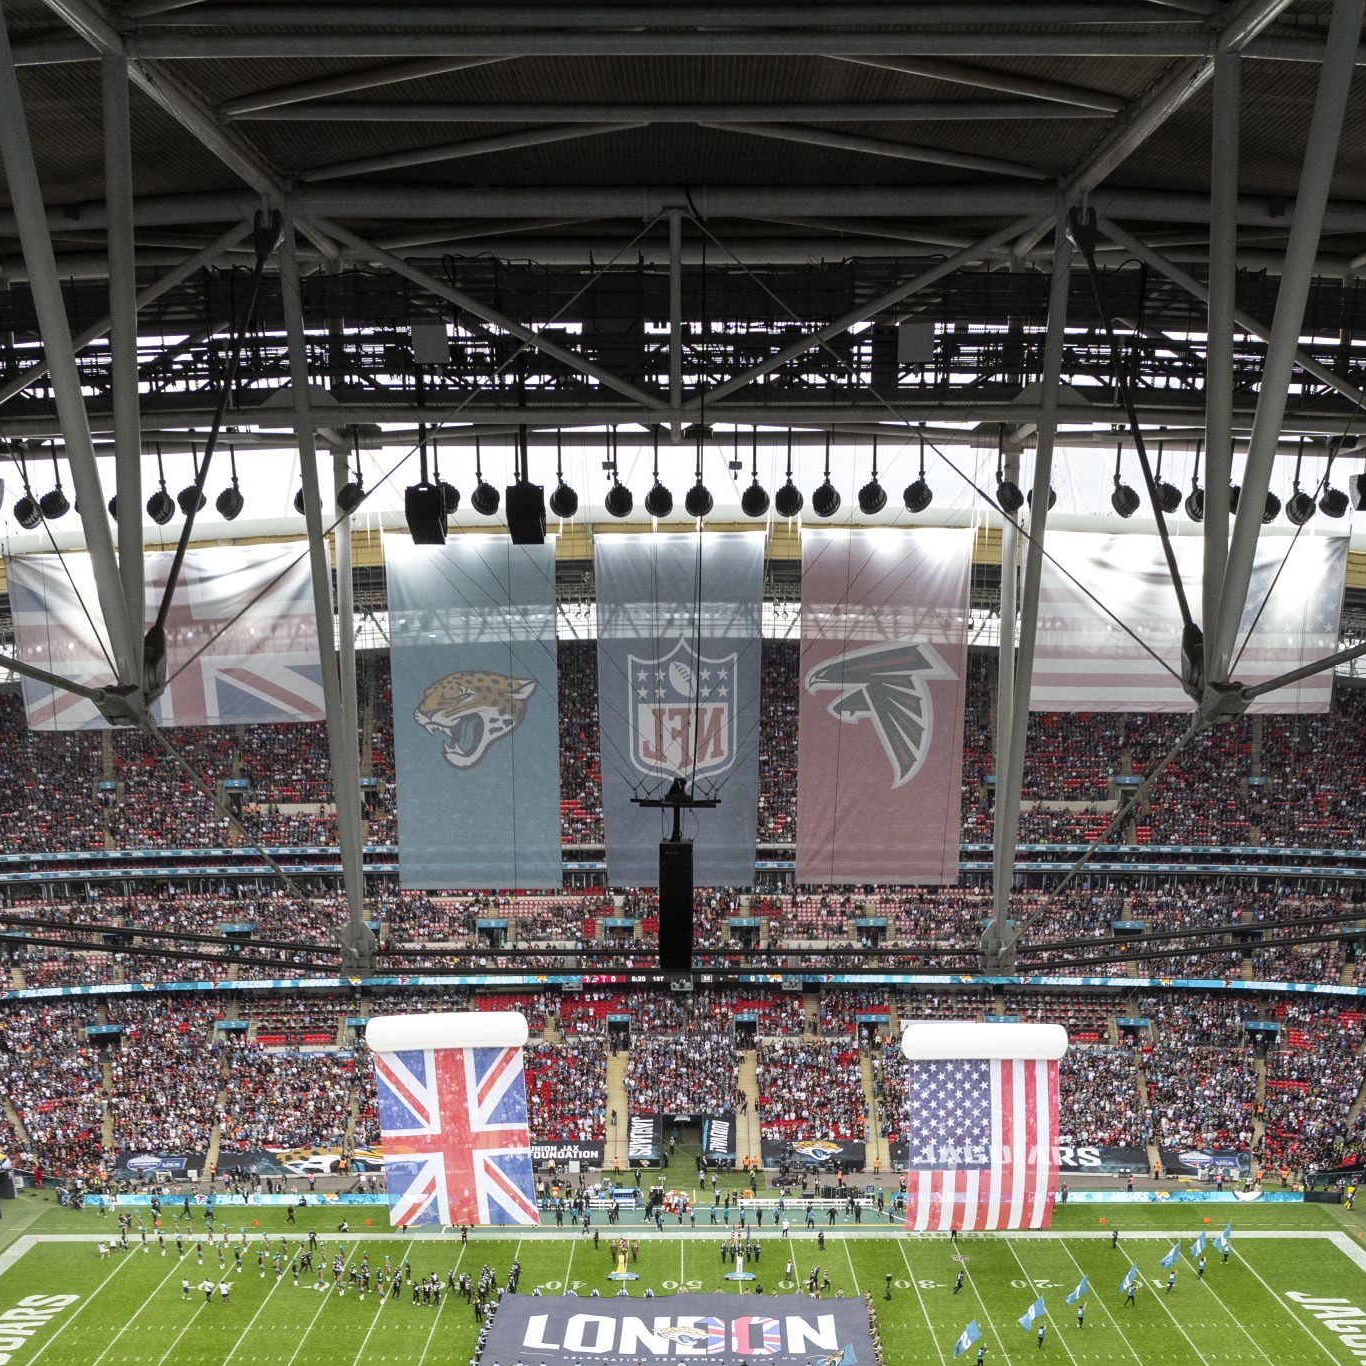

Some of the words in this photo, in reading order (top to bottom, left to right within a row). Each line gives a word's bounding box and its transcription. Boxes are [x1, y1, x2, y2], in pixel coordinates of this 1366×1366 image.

[560, 1144, 580, 1152] JAX
[629, 1116, 654, 1156] JAGUARS
[710, 1119, 730, 1154] DUUVAL
[522, 1313, 840, 1356] LONDON
